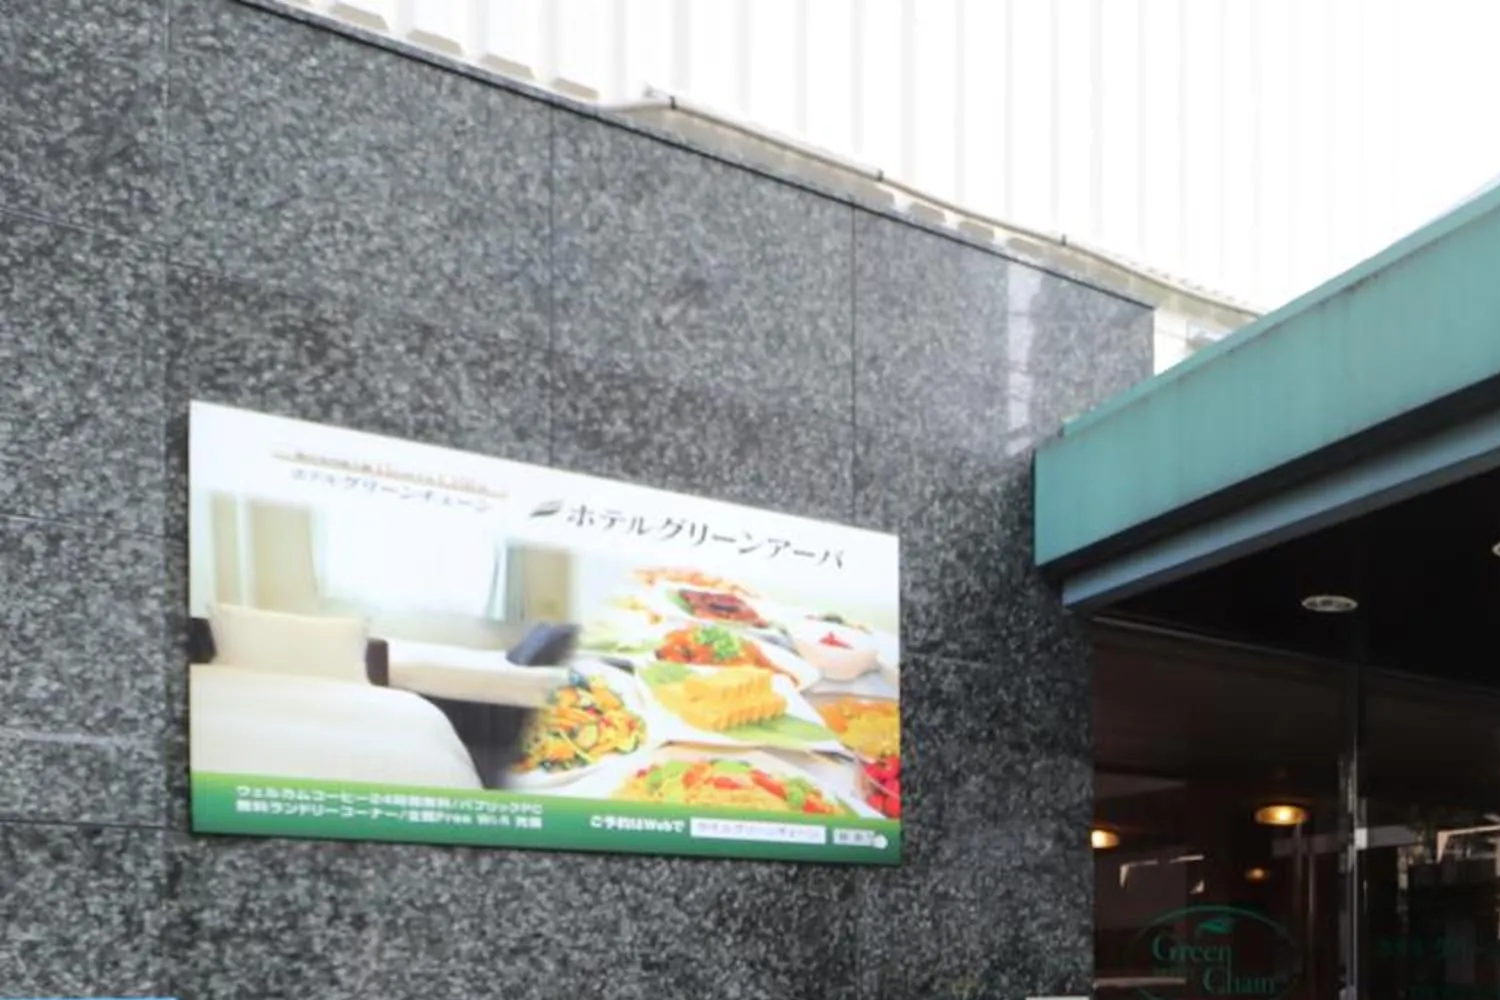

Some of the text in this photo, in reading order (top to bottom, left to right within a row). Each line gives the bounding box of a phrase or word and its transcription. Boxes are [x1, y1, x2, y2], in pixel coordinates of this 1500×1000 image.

[566, 504, 845, 569] ホテルグリーンアーバ
[1151, 932, 1232, 963] Green
[1202, 965, 1275, 995] Chain
